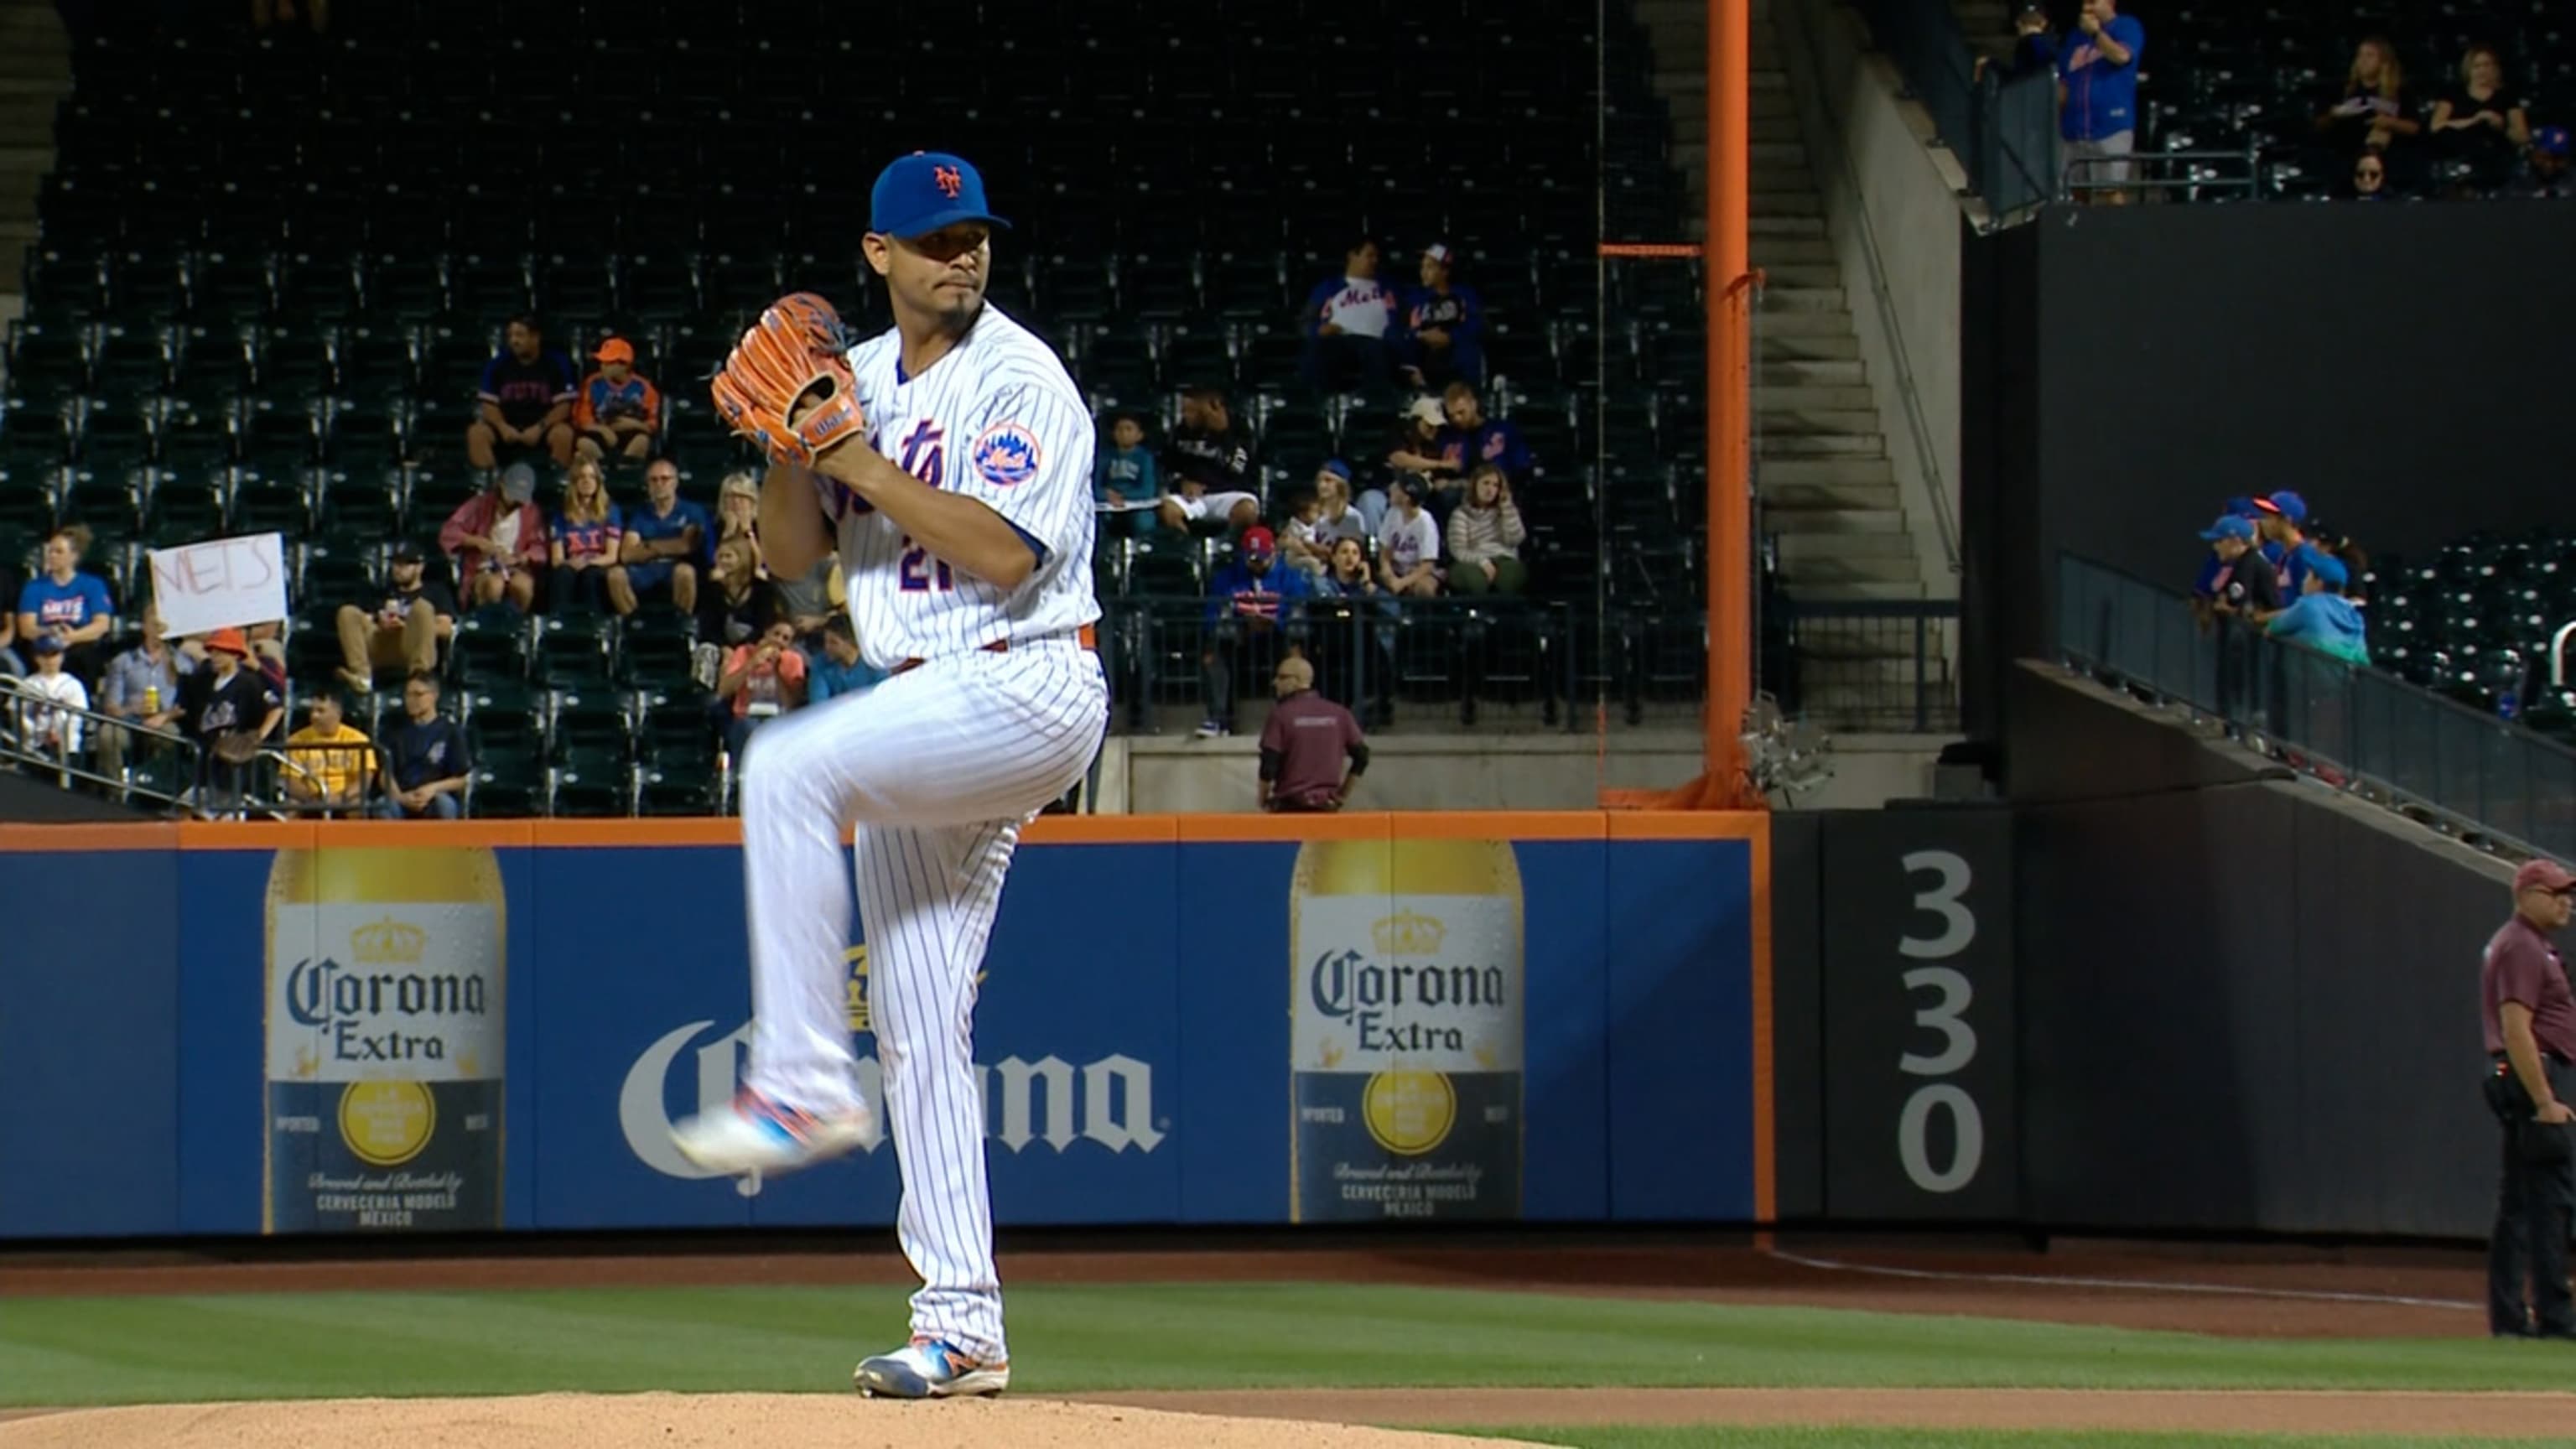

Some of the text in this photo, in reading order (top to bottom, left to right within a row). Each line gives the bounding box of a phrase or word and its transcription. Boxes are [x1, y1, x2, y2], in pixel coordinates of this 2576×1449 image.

[286, 958, 486, 1036] Corona
[1311, 948, 1504, 1026] Corona
[335, 1019, 444, 1061] Extra
[1357, 1011, 1464, 1052] Extra
